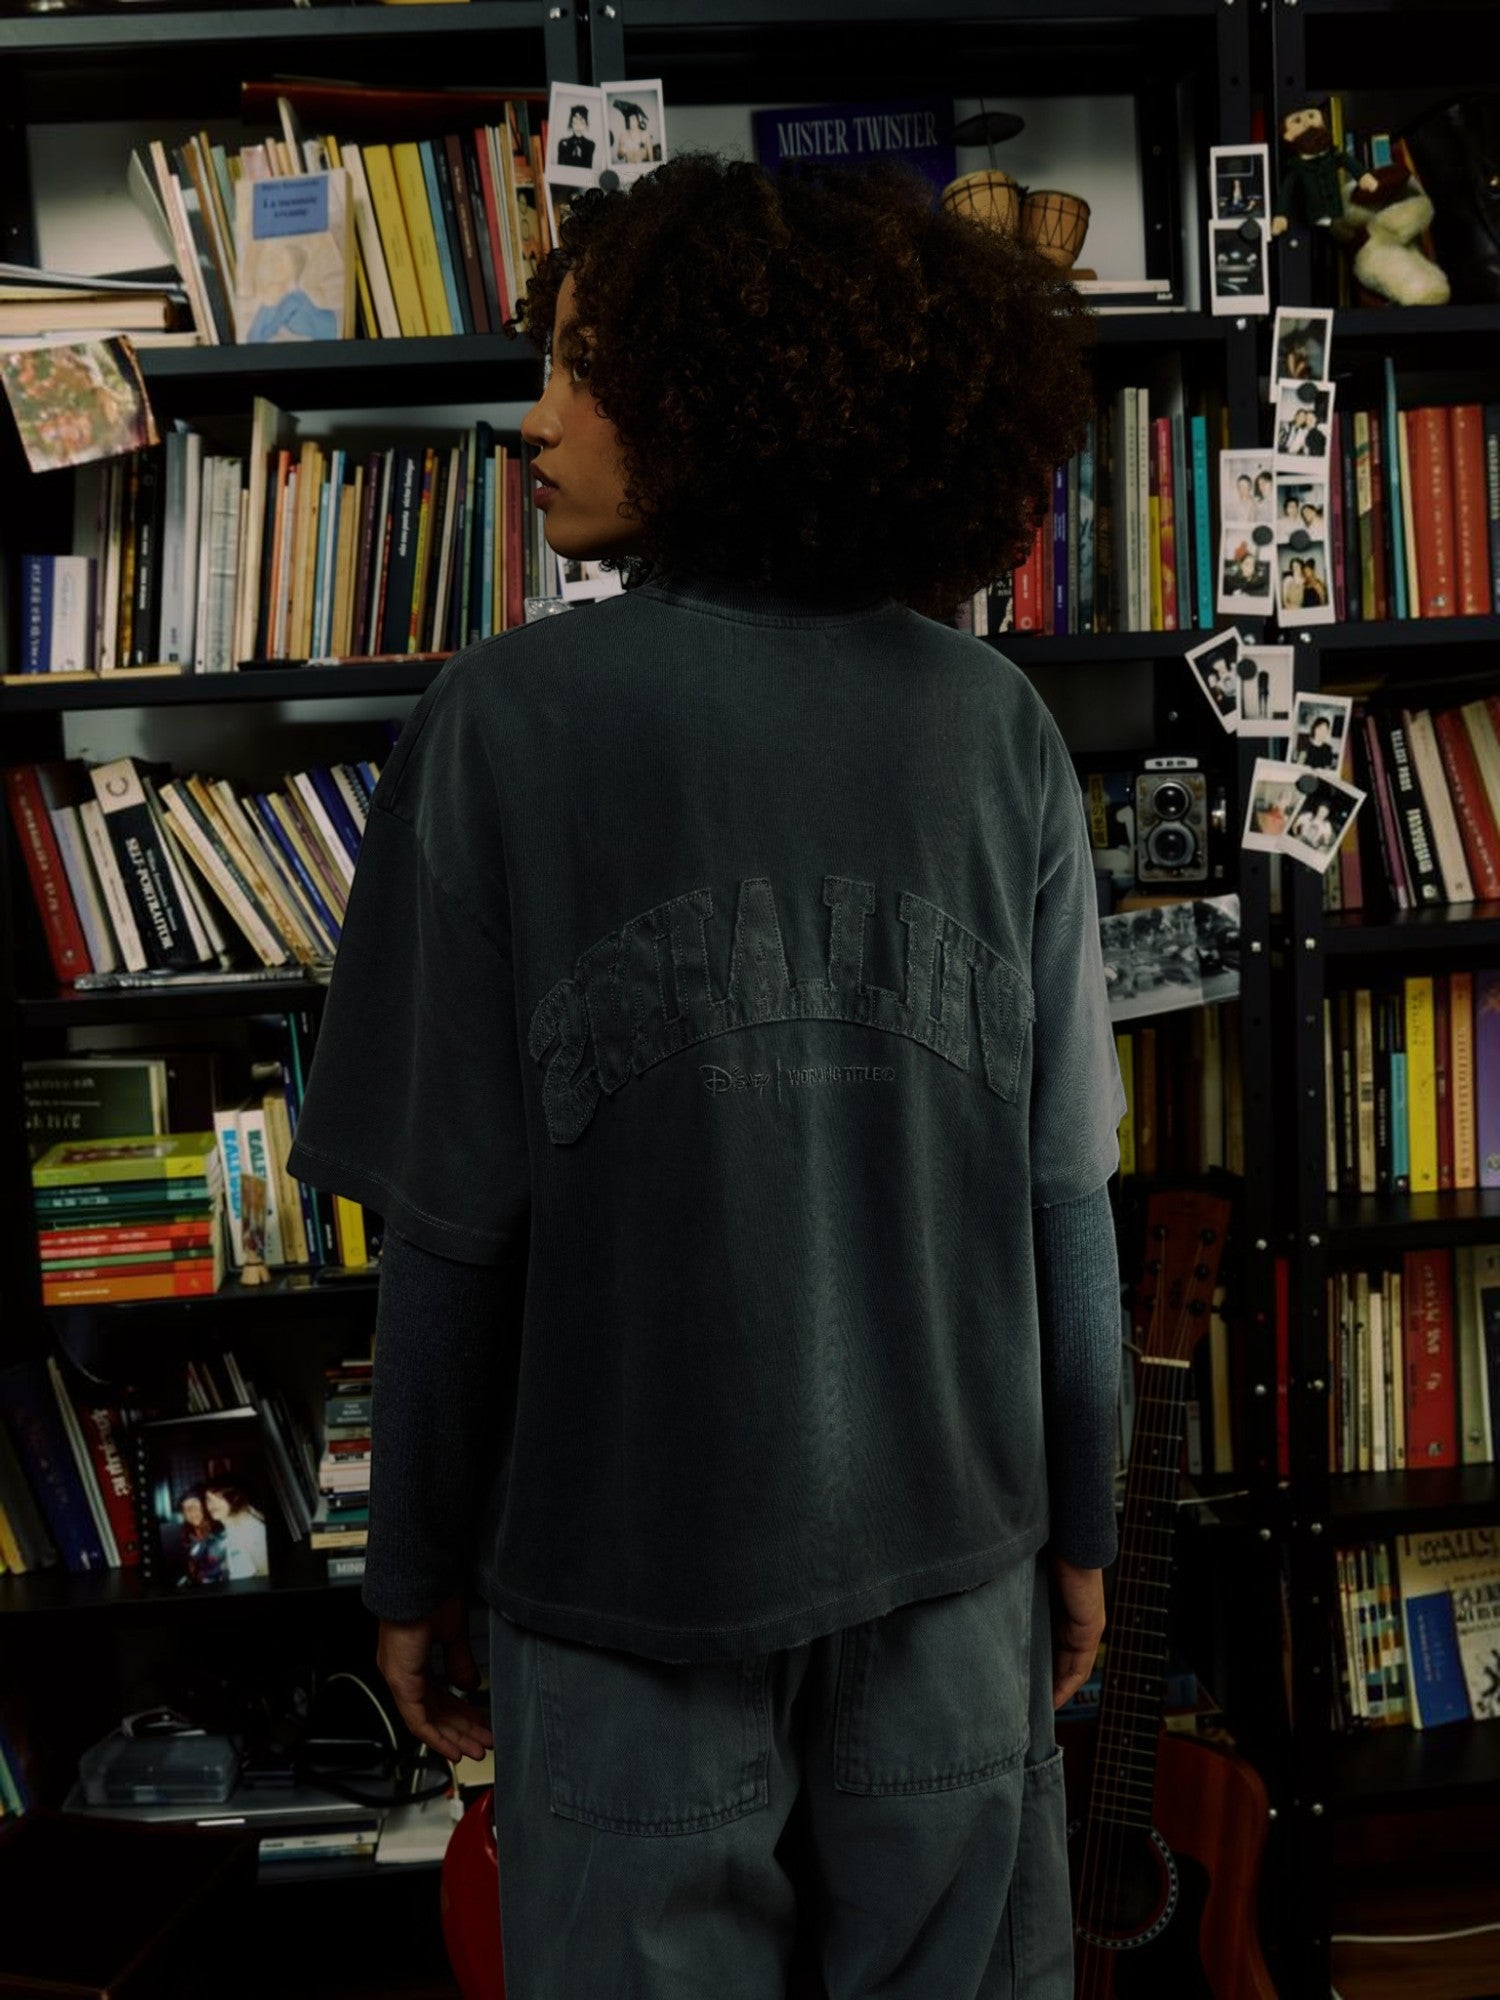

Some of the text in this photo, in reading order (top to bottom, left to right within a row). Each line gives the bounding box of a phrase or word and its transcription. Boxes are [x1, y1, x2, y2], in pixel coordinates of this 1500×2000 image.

[777, 112, 939, 158] MISTER TWISTER
[698, 1064, 772, 1097] Disney
